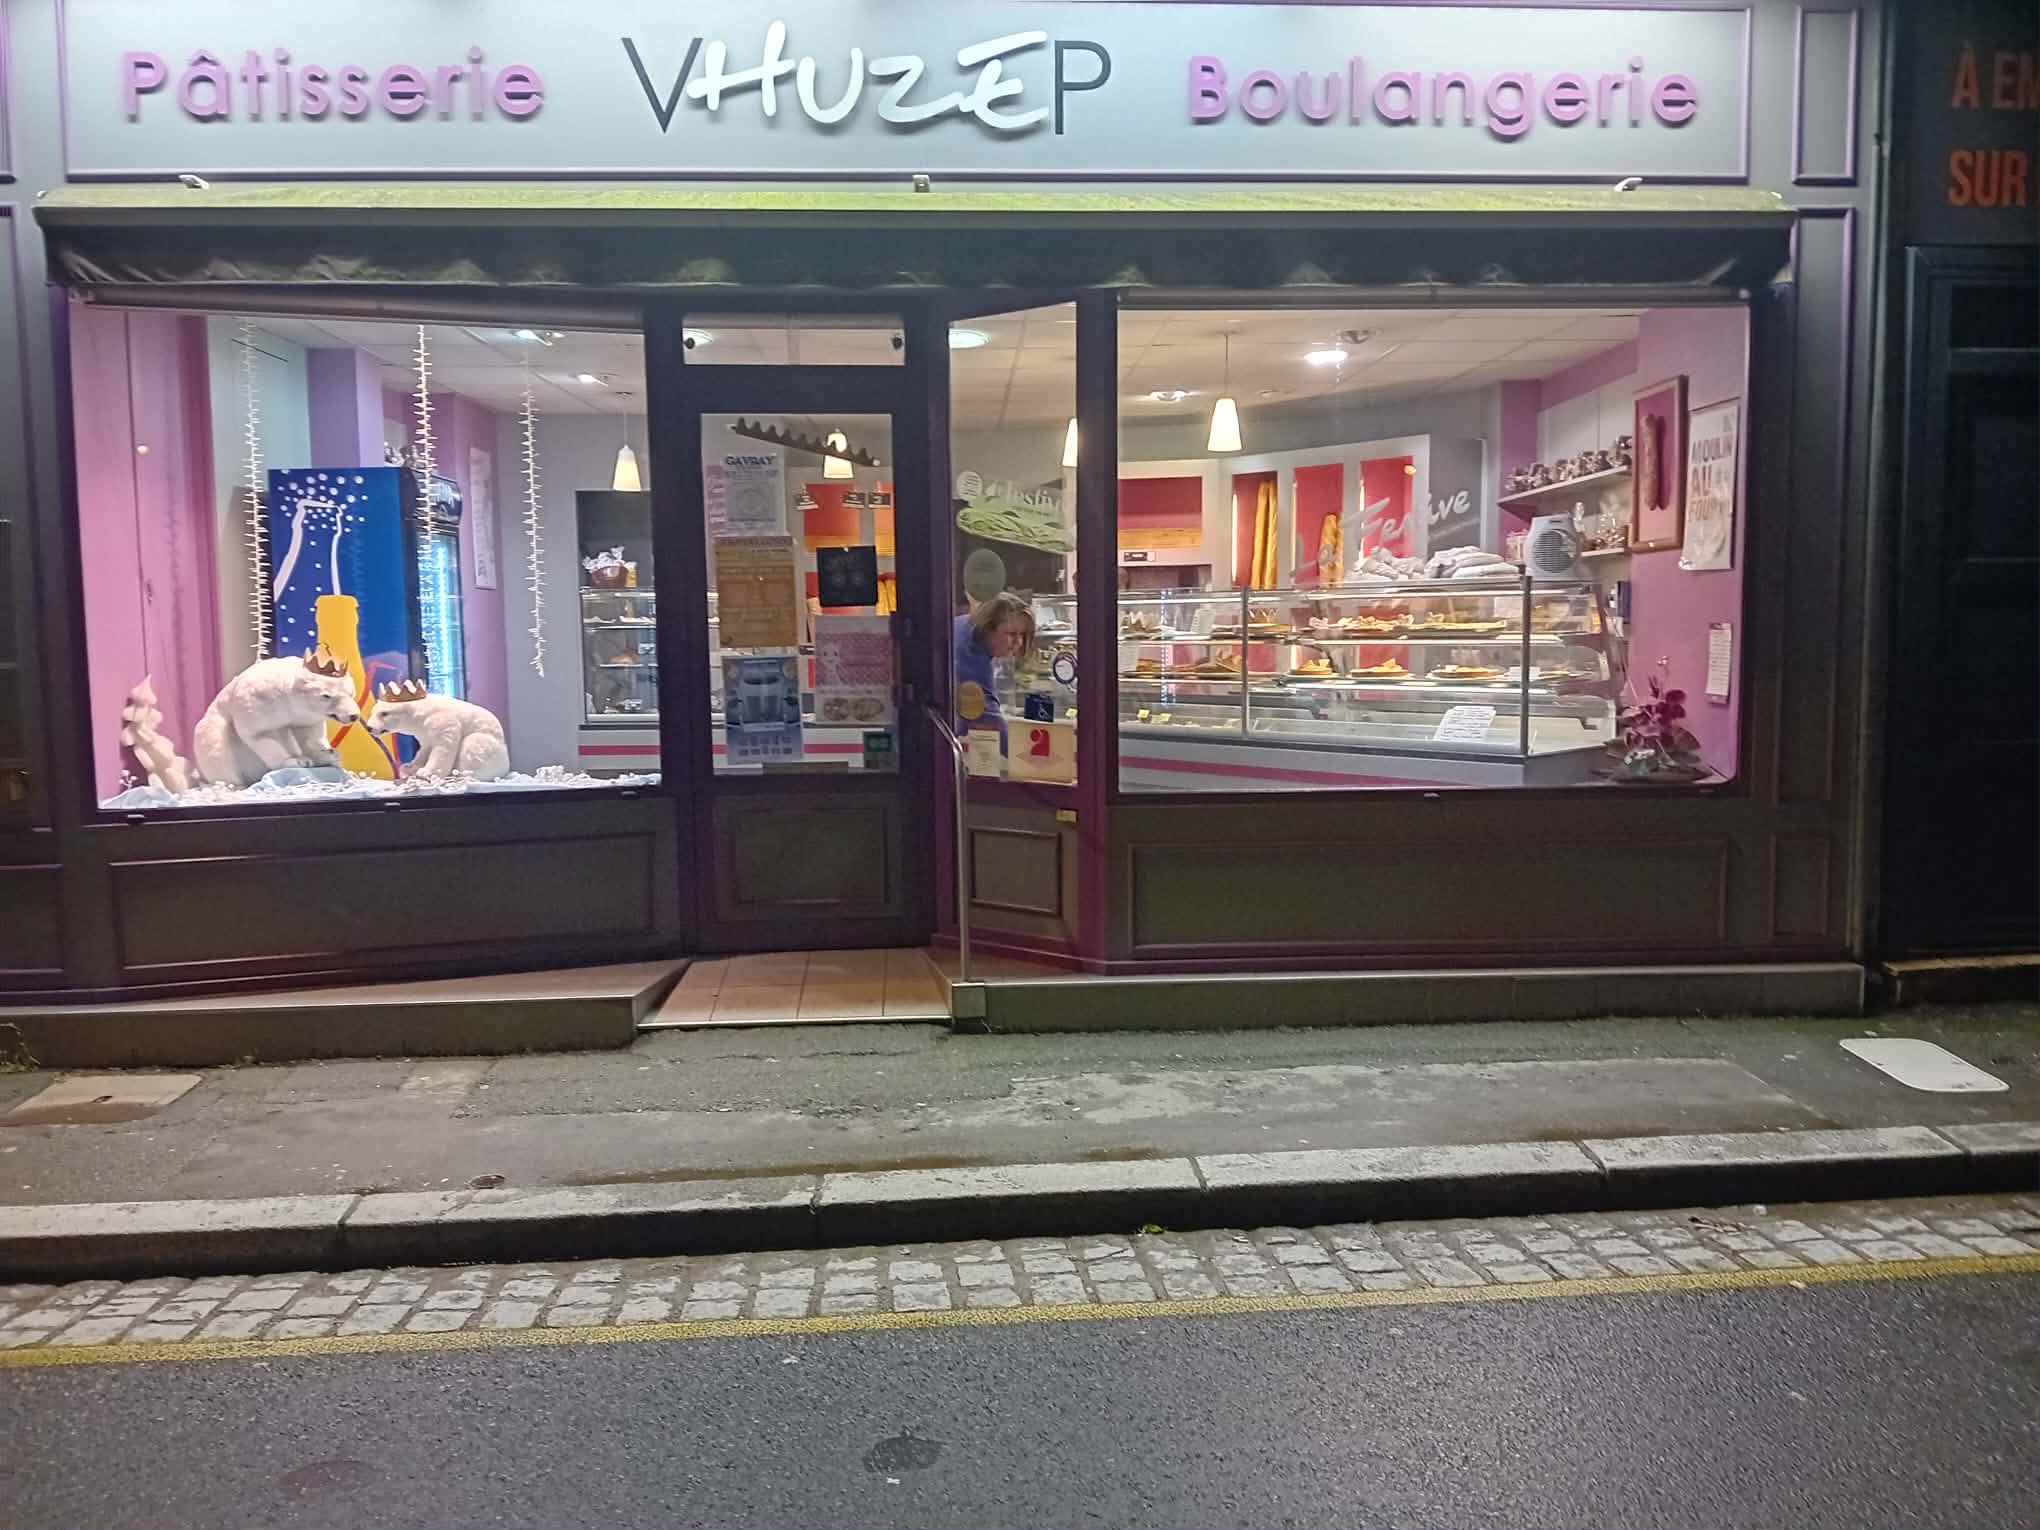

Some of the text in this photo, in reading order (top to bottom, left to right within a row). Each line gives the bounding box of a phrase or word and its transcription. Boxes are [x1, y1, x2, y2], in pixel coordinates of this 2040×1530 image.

[121, 46, 543, 121] Pâtisserie
[1188, 55, 1697, 140] Boulangerie
[1948, 149, 2027, 207] SUR
[1691, 465, 1712, 497] AU
